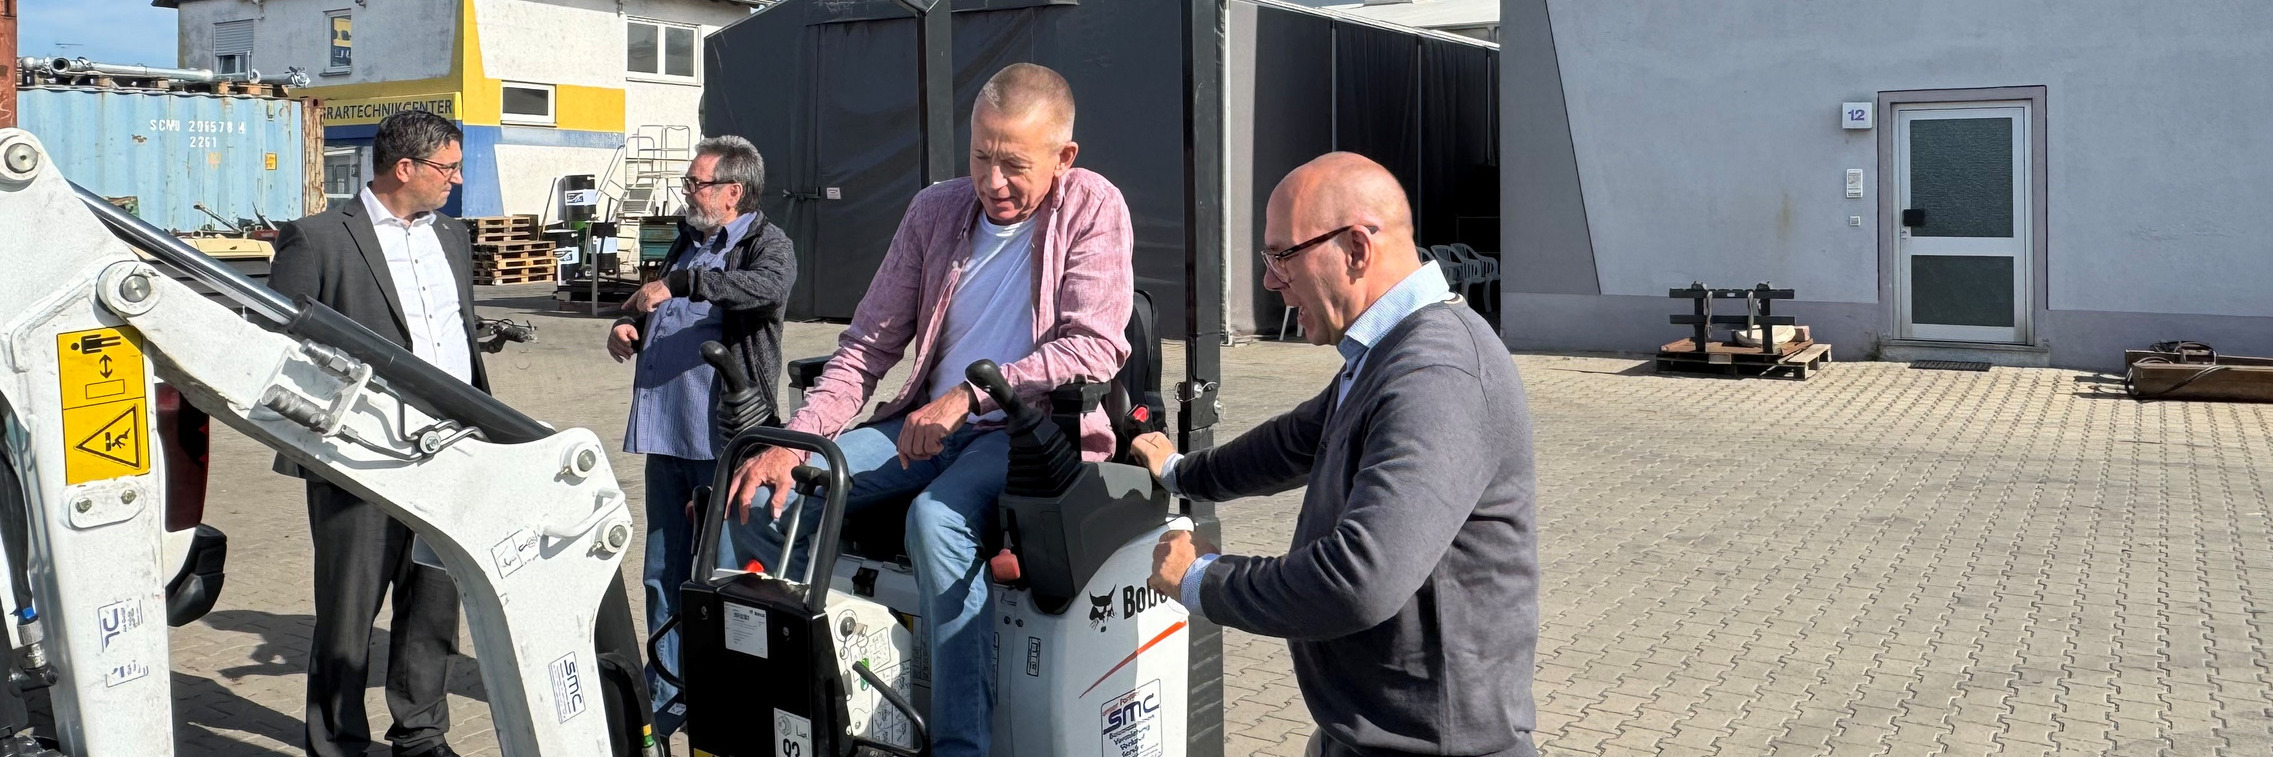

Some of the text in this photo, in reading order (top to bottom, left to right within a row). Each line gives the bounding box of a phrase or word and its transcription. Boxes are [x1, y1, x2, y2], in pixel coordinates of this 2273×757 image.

[1848, 109, 1865, 121] 12
[188, 120, 234, 134] 206578
[189, 136, 218, 148] 2261
[1122, 585, 1168, 620] Bob
